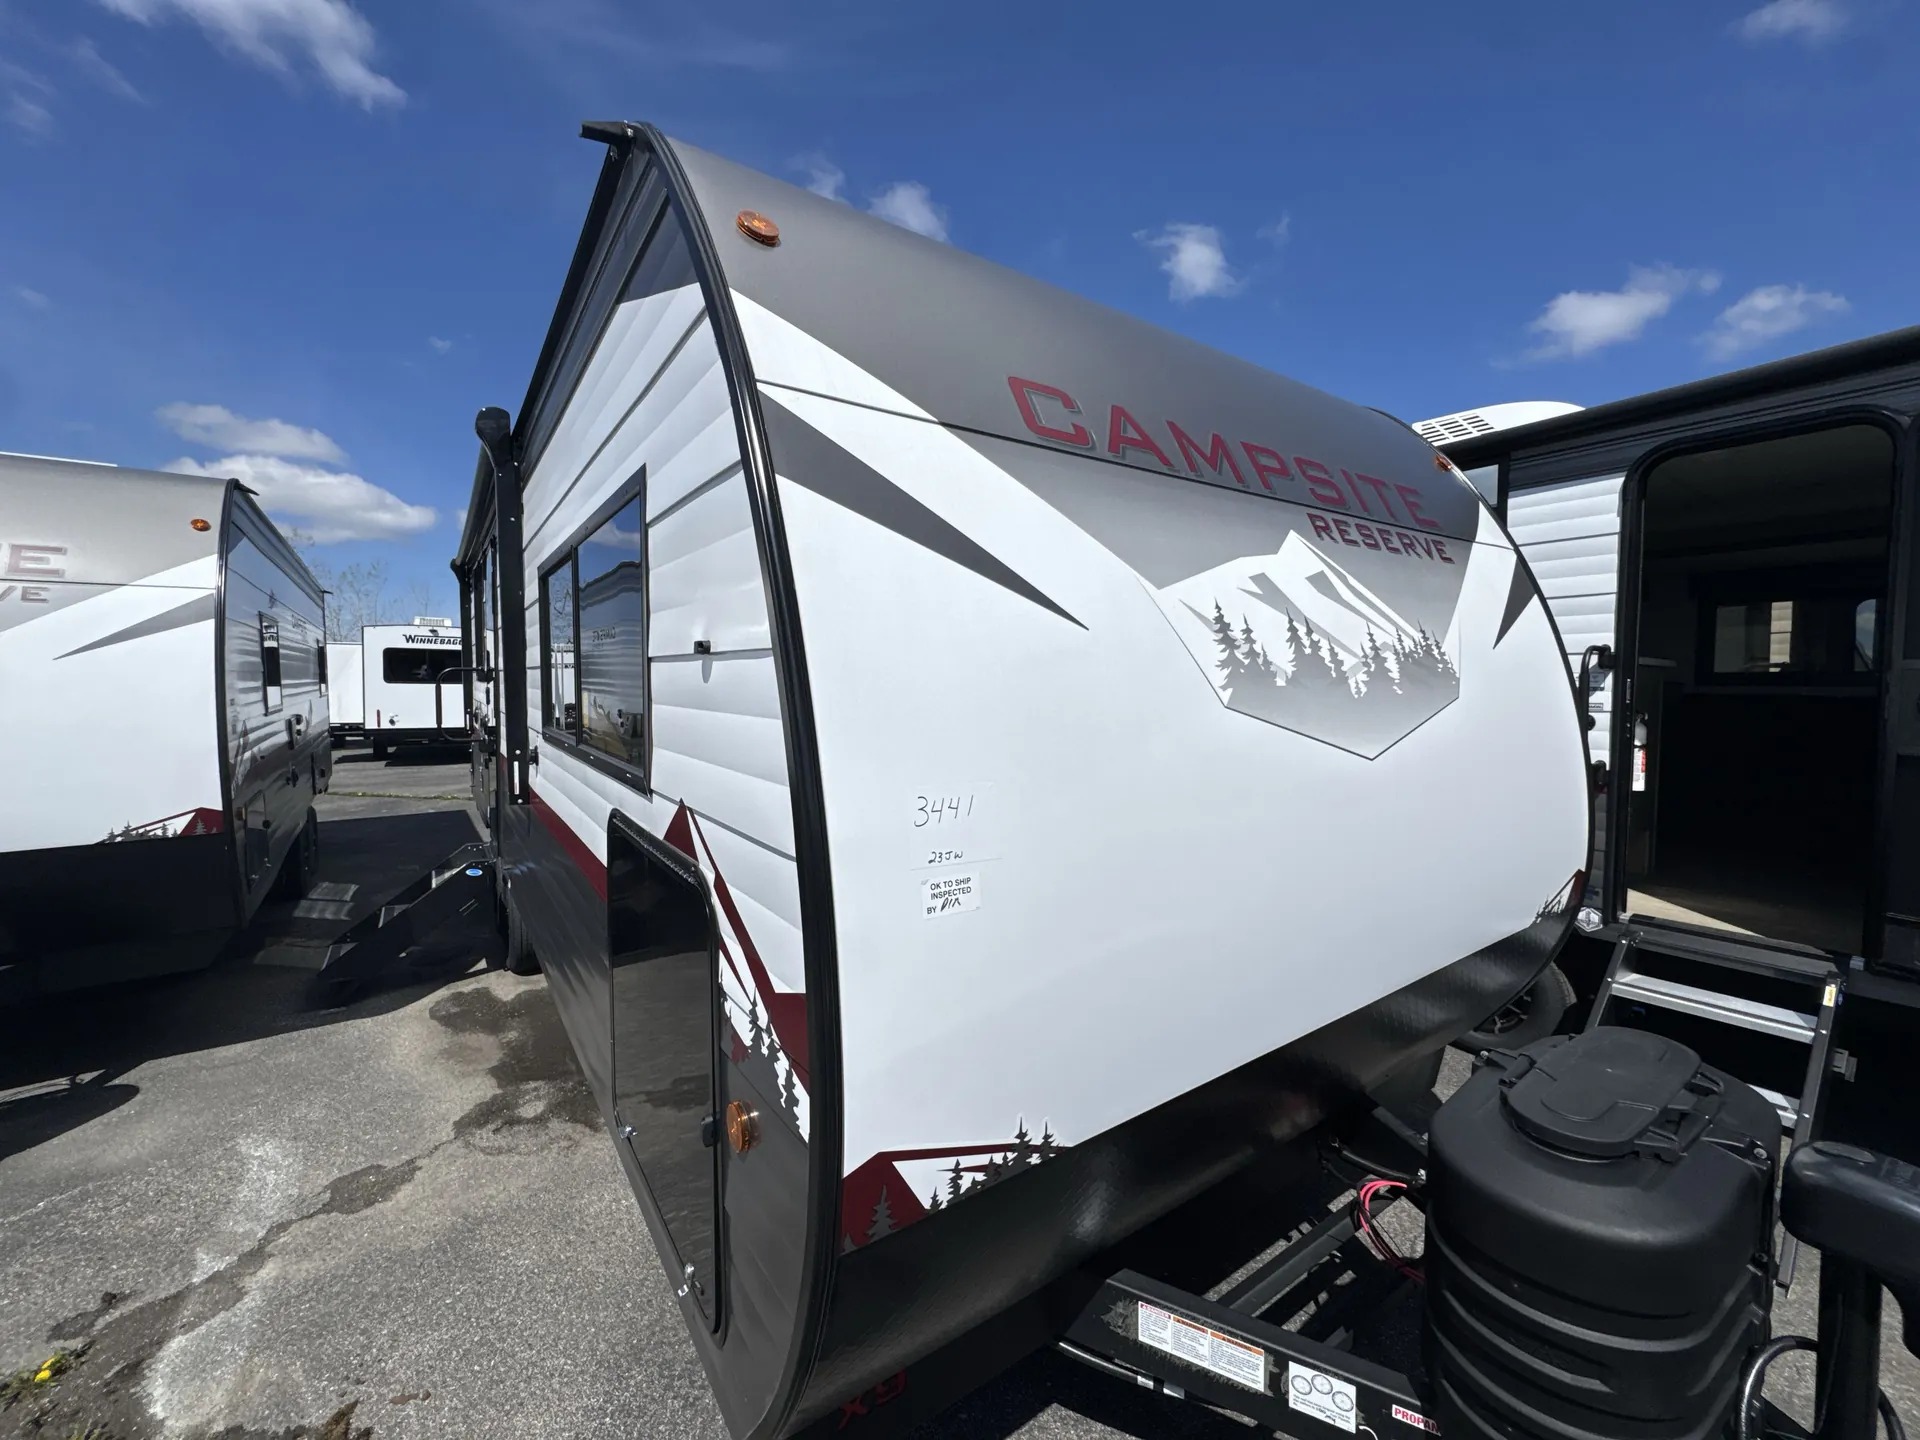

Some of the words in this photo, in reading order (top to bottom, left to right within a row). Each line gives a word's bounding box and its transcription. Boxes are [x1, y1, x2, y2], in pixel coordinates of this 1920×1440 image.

[1007, 375, 1442, 529] CAMPSITE
[1306, 512, 1456, 565] RESERVE
[913, 794, 974, 828] 3441
[930, 882, 942, 891] OK
[943, 880, 953, 888] TO
[954, 877, 972, 886] SHIP
[930, 887, 972, 900] INSPECTED
[926, 906, 937, 915] BY
[1394, 1407, 1439, 1433] PROPAN
